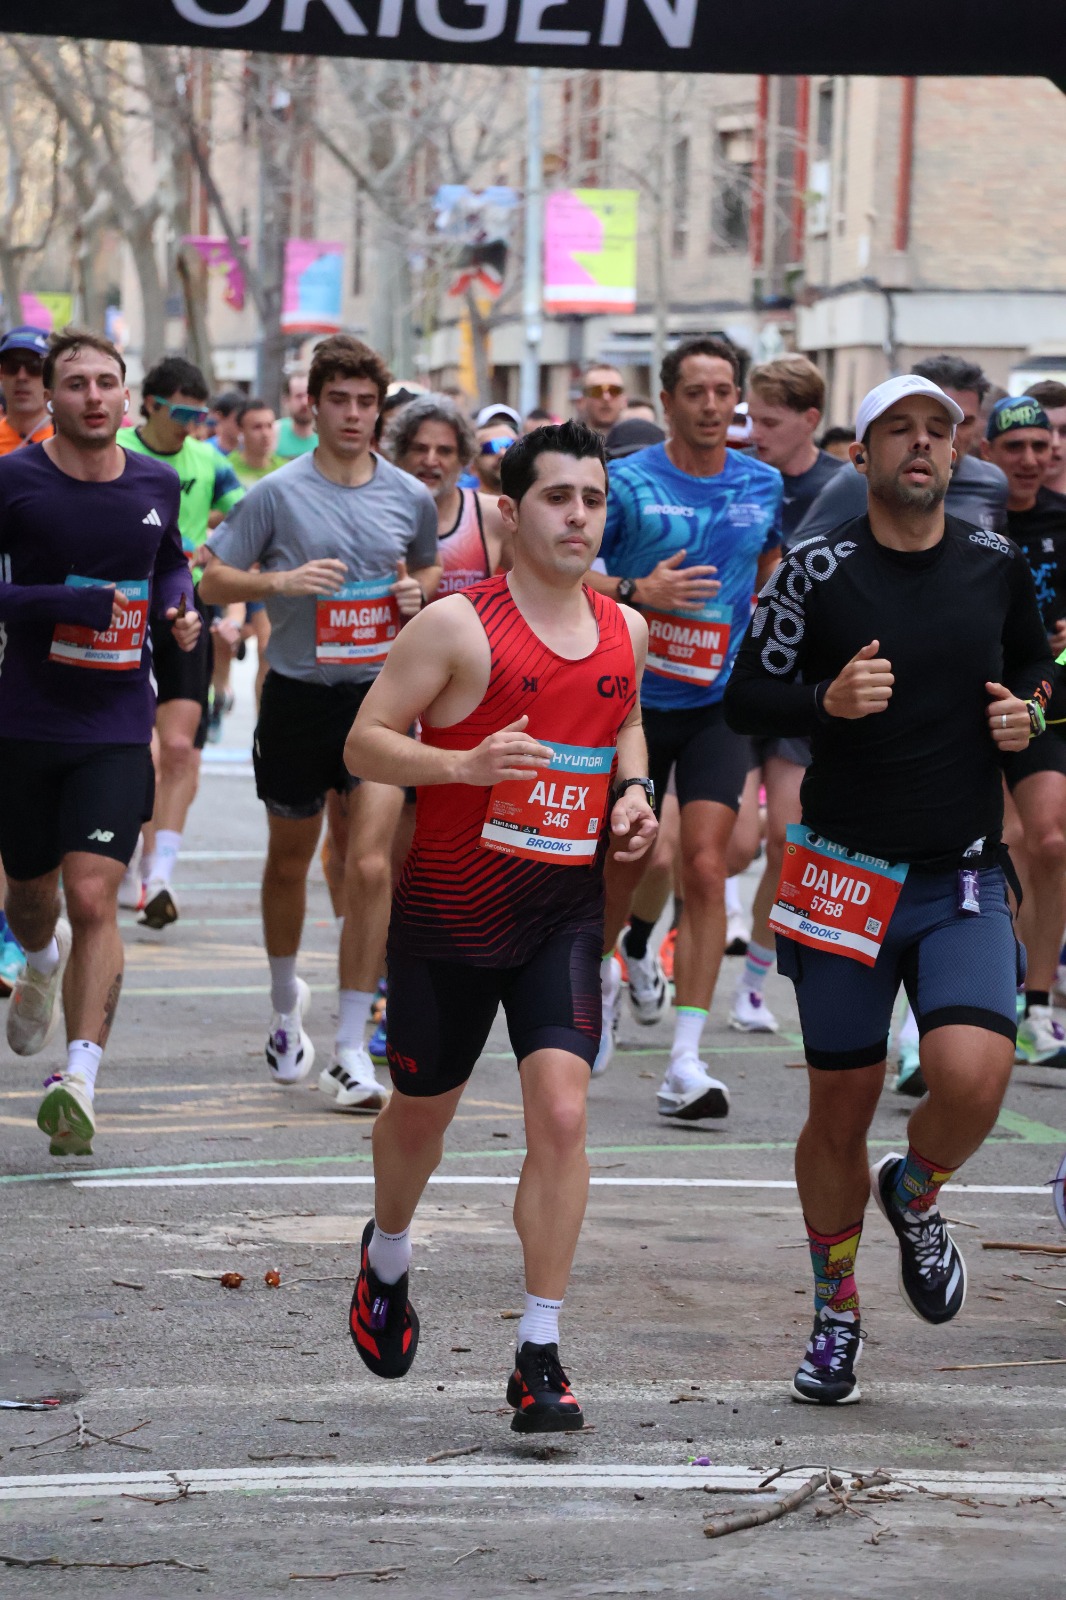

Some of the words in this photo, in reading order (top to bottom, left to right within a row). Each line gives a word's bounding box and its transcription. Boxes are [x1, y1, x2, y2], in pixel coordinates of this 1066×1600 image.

[329, 605, 392, 628] MAGMA
[93, 630, 119, 643] 7431
[649, 619, 721, 650] ROMAIN
[552, 752, 604, 768] HYUNDAI
[527, 780, 590, 811] ALEX
[542, 810, 570, 829] 346
[526, 837, 573, 852] BROOKS
[800, 862, 872, 906] DAVID
[810, 895, 844, 918] 5758
[798, 920, 842, 941] BROOKS
